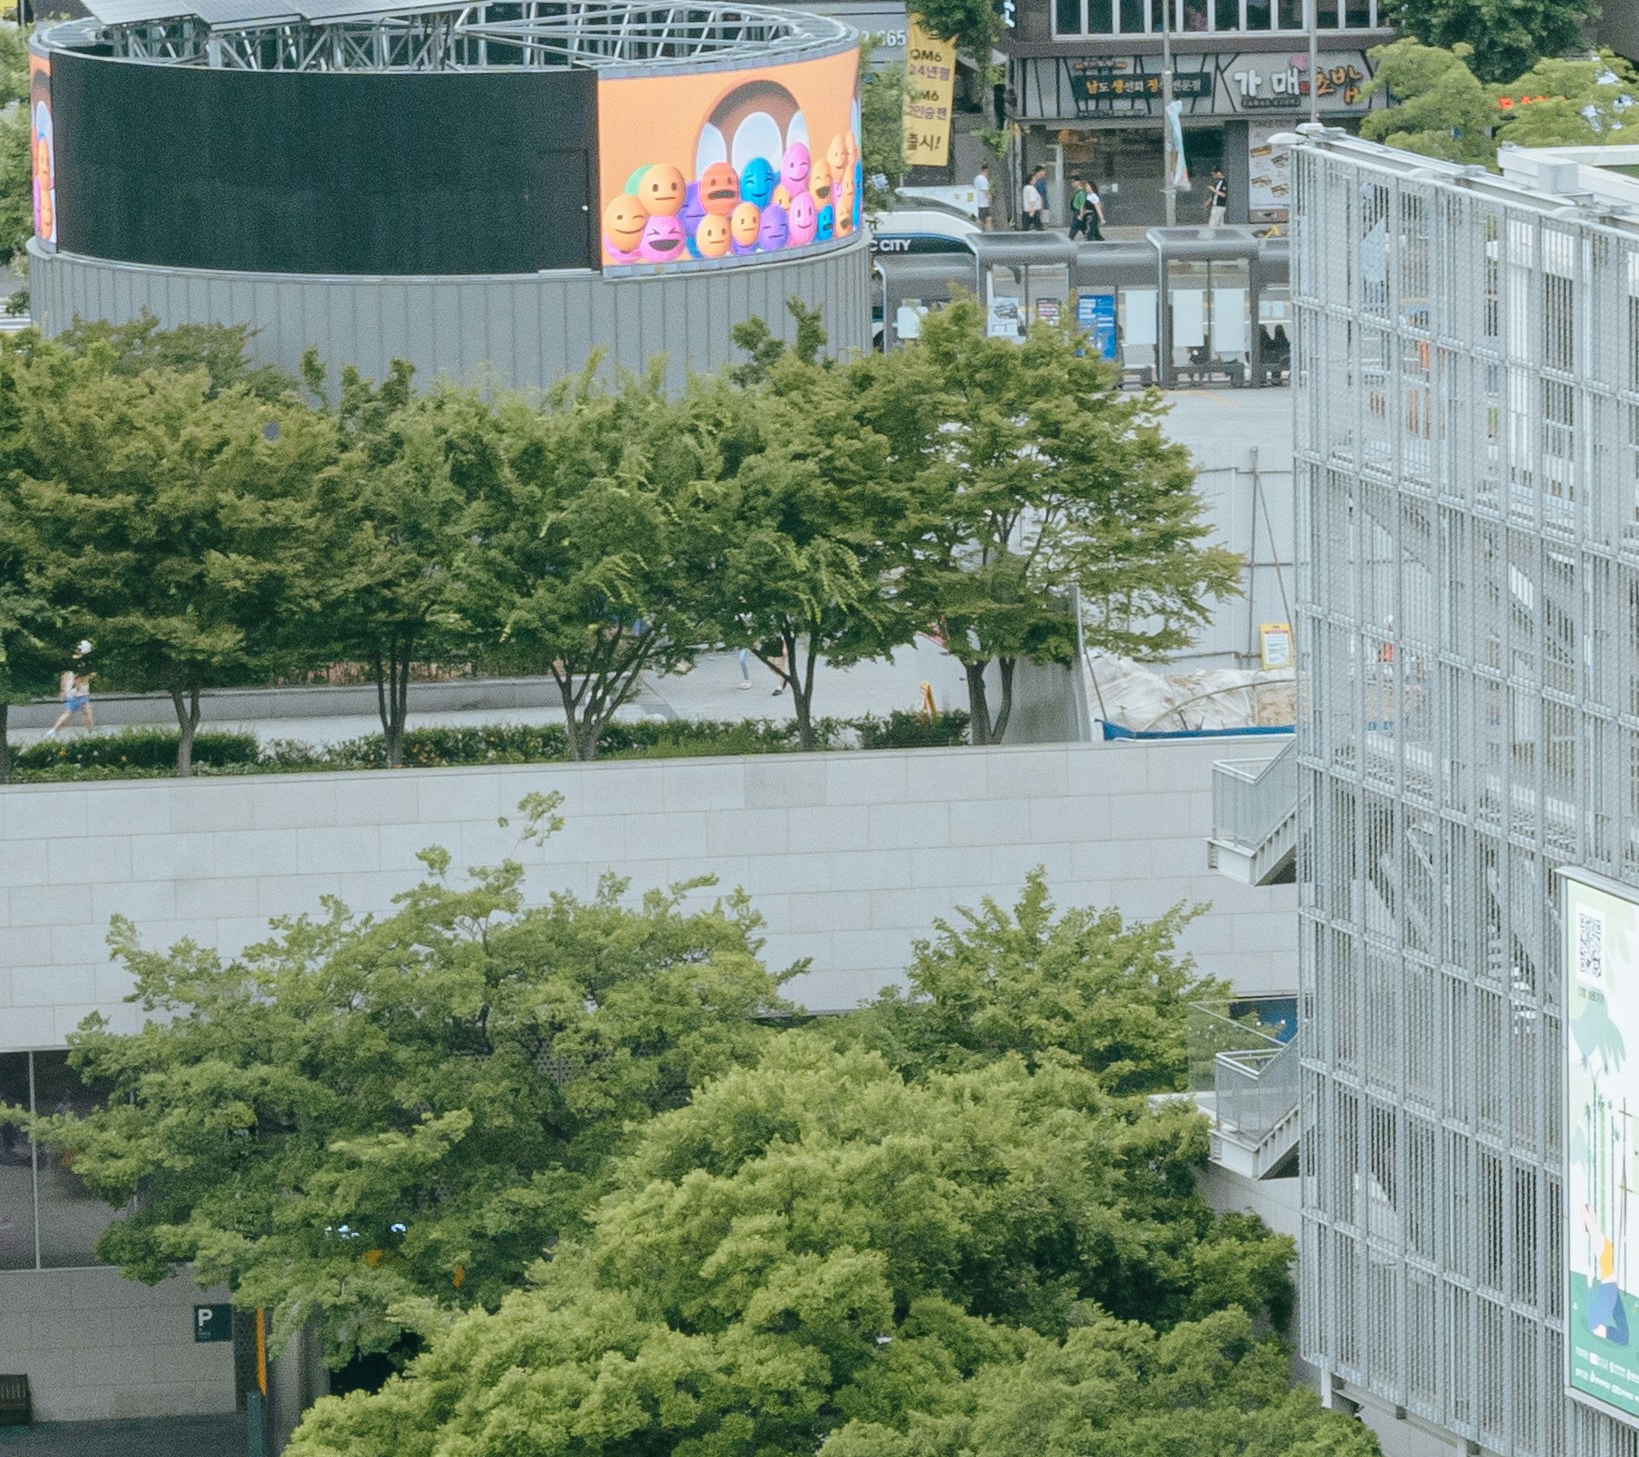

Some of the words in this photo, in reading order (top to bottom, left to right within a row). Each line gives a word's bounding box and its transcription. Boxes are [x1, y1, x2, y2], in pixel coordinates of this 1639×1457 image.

[910, 48, 943, 62] QM6
[907, 132, 941, 151] 출시!
[879, 239, 912, 251] CITY
